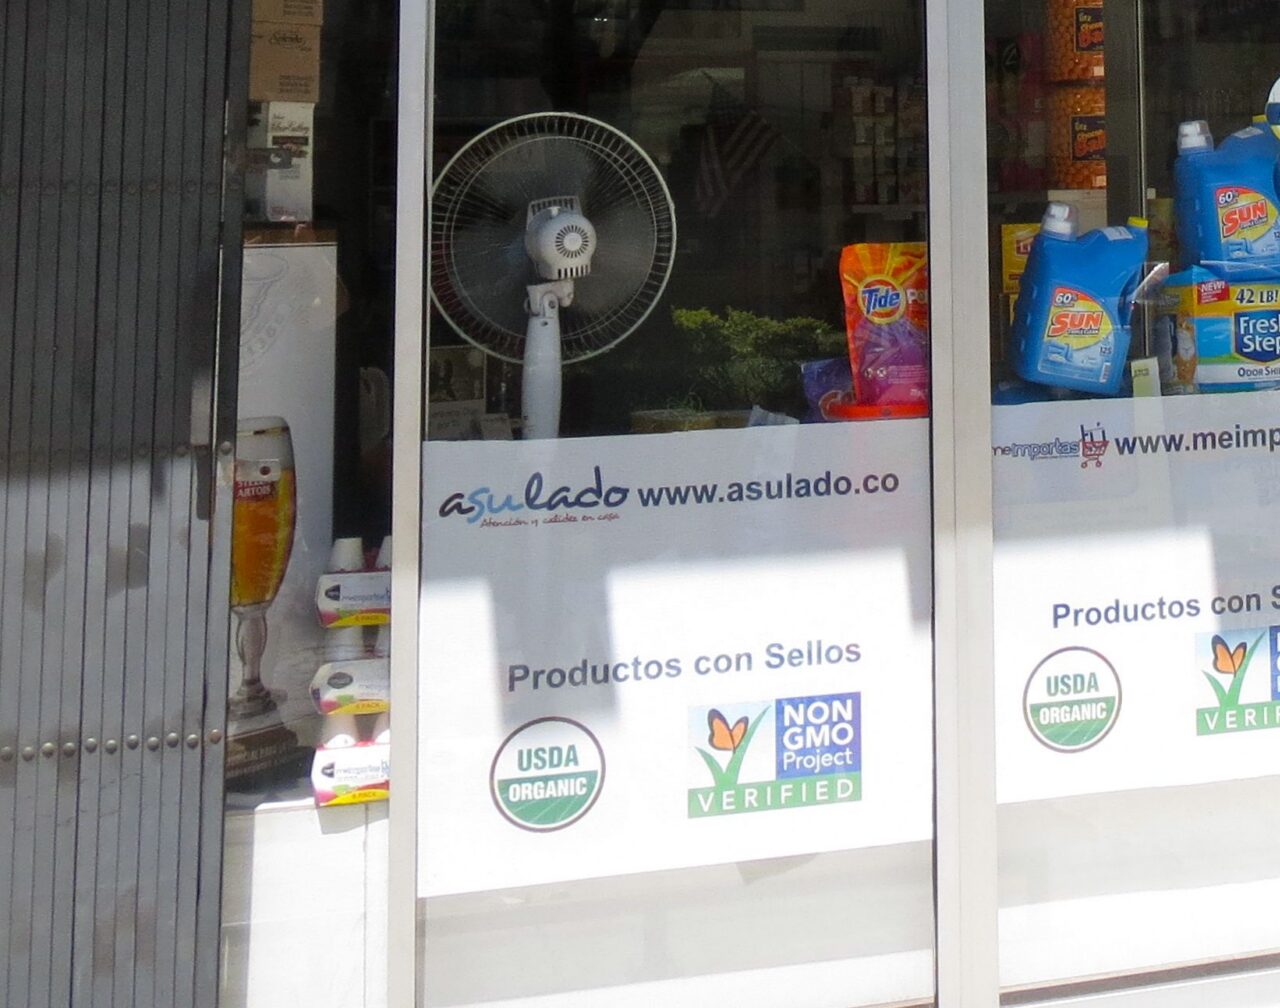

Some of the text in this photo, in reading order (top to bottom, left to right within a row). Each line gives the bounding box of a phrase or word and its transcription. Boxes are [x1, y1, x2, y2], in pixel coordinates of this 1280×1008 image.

[1221, 199, 1267, 238] SUN
[1199, 280, 1226, 293] NEW!
[1235, 288, 1255, 304] 42
[1259, 289, 1279, 304] LB!
[861, 288, 901, 315] Tide
[1047, 311, 1103, 337] SUN
[438, 464, 901, 524] asulado www.asulado.co
[1052, 595, 1201, 628] Productos
[1210, 589, 1262, 614] con
[508, 640, 862, 692] Productos con Sellos
[1046, 672, 1099, 696] USDA
[783, 698, 853, 725] NON
[1039, 702, 1107, 725] ORGANIC
[783, 722, 854, 749] GMO
[516, 745, 580, 772] USDA
[783, 749, 854, 774] Project
[508, 777, 588, 803] ORGANIC
[697, 778, 855, 813] VERIFIED
